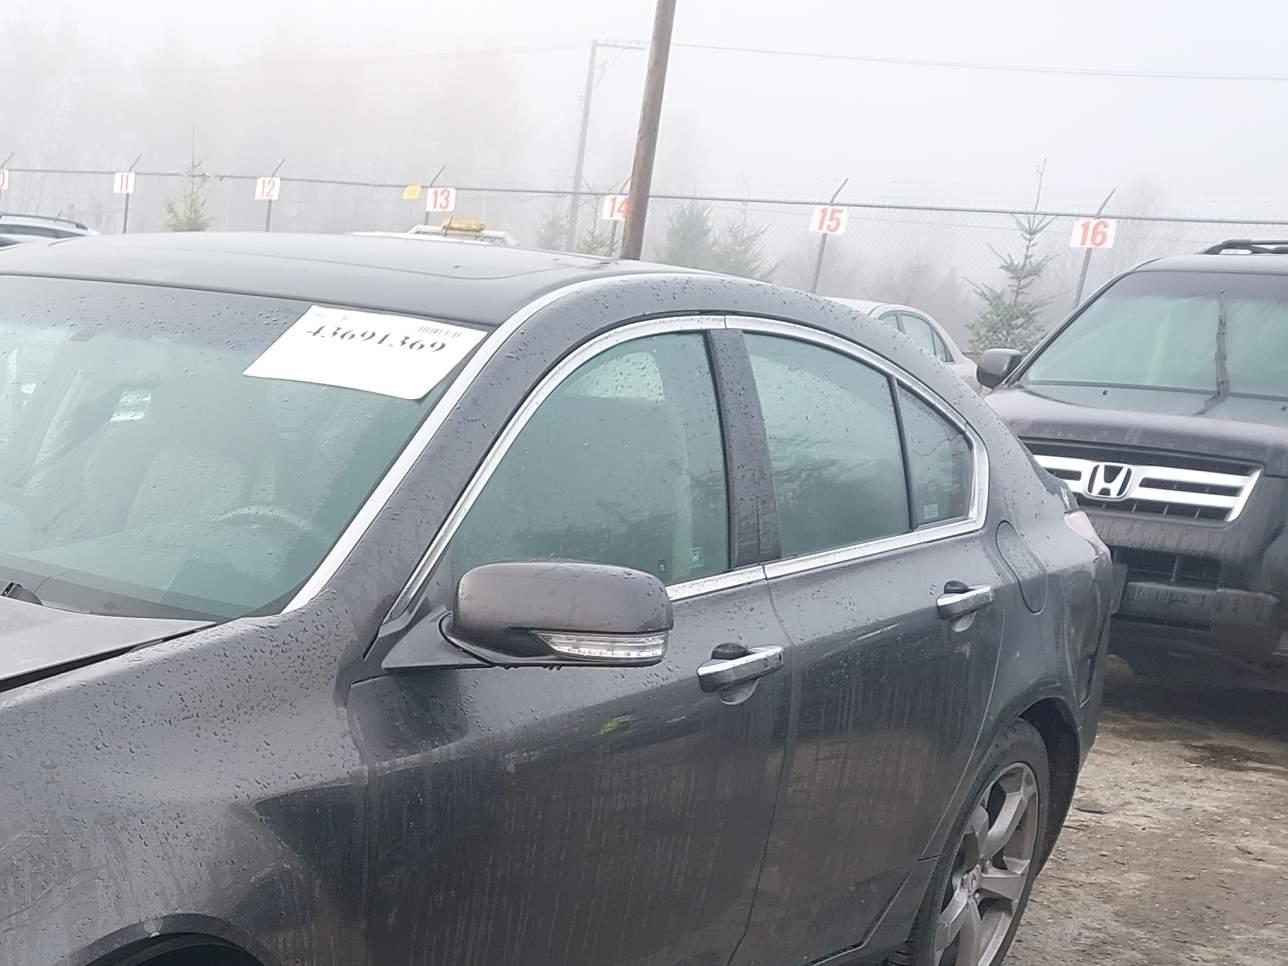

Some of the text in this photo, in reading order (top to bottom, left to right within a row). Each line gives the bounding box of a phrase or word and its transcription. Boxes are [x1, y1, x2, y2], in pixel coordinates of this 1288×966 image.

[119, 175, 130, 191] 11
[261, 180, 276, 198] 12
[431, 190, 451, 209] 13
[816, 207, 845, 233] 15
[1080, 219, 1110, 247] 16
[306, 325, 447, 353] 43691369
